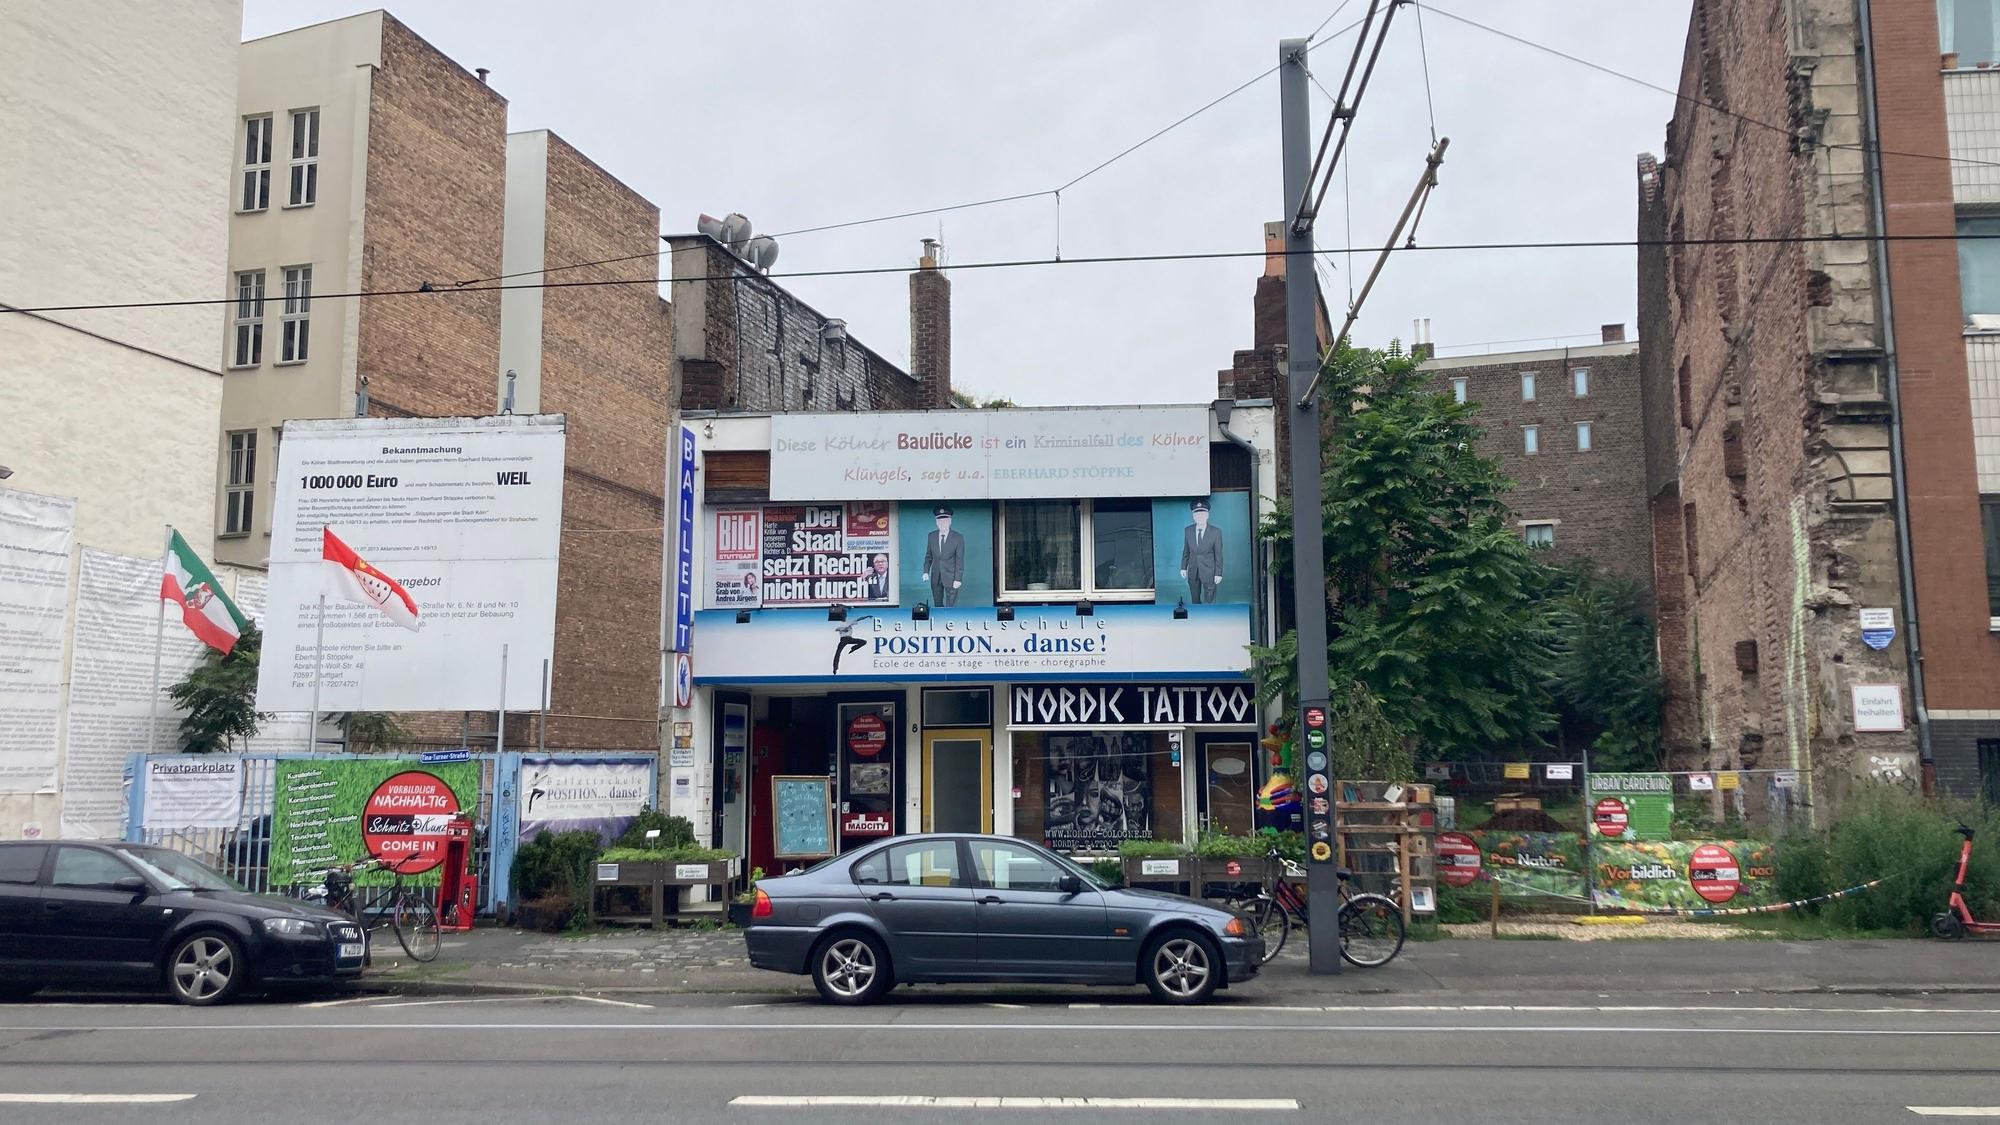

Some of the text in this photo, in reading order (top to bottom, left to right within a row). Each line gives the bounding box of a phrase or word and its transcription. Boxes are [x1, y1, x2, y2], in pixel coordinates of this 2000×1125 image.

[776, 432, 1205, 450] Diese Kölner Baulücke ist ein Kriminalfall des Kölner
[382, 446, 462, 454] Bekanntmachung
[366, 474, 398, 488] Euro
[496, 472, 532, 486] WEIL
[844, 466, 1134, 485] Klüngels, sagt u.a. EBERHARD STÖPPKE
[720, 514, 756, 550] Bild
[680, 438, 692, 648] BALLETT
[792, 530, 842, 552] Staat
[764, 554, 868, 576] setzt Recht
[395, 576, 442, 588] angebot
[764, 578, 810, 600] nicht
[736, 594, 757, 602] Jürgens
[480, 610, 514, 618] Bebauung
[873, 635, 1016, 655] POSITION...
[903, 658, 915, 668] de
[918, 658, 946, 668] danse
[958, 658, 983, 670] stage
[1041, 656, 1106, 669] chorégraphie
[1016, 686, 1249, 723] NORDIC TATTOO
[1862, 698, 1893, 706] Einfahrt
[912, 724, 918, 733] 8
[152, 762, 236, 774] Privatparkplatz
[388, 785, 436, 794] VORBILDLICH
[1592, 776, 1671, 790] URBAN GARDENING
[546, 786, 642, 800] POSITION... danse!
[374, 794, 448, 808] NACHHALTIG
[421, 816, 448, 832] Kunz
[382, 840, 435, 850] COME IN
[1052, 840, 1121, 848] NORDIC_TATTOO_
[1490, 852, 1516, 864] Pro
[1606, 864, 1676, 879] Vorbildlich
